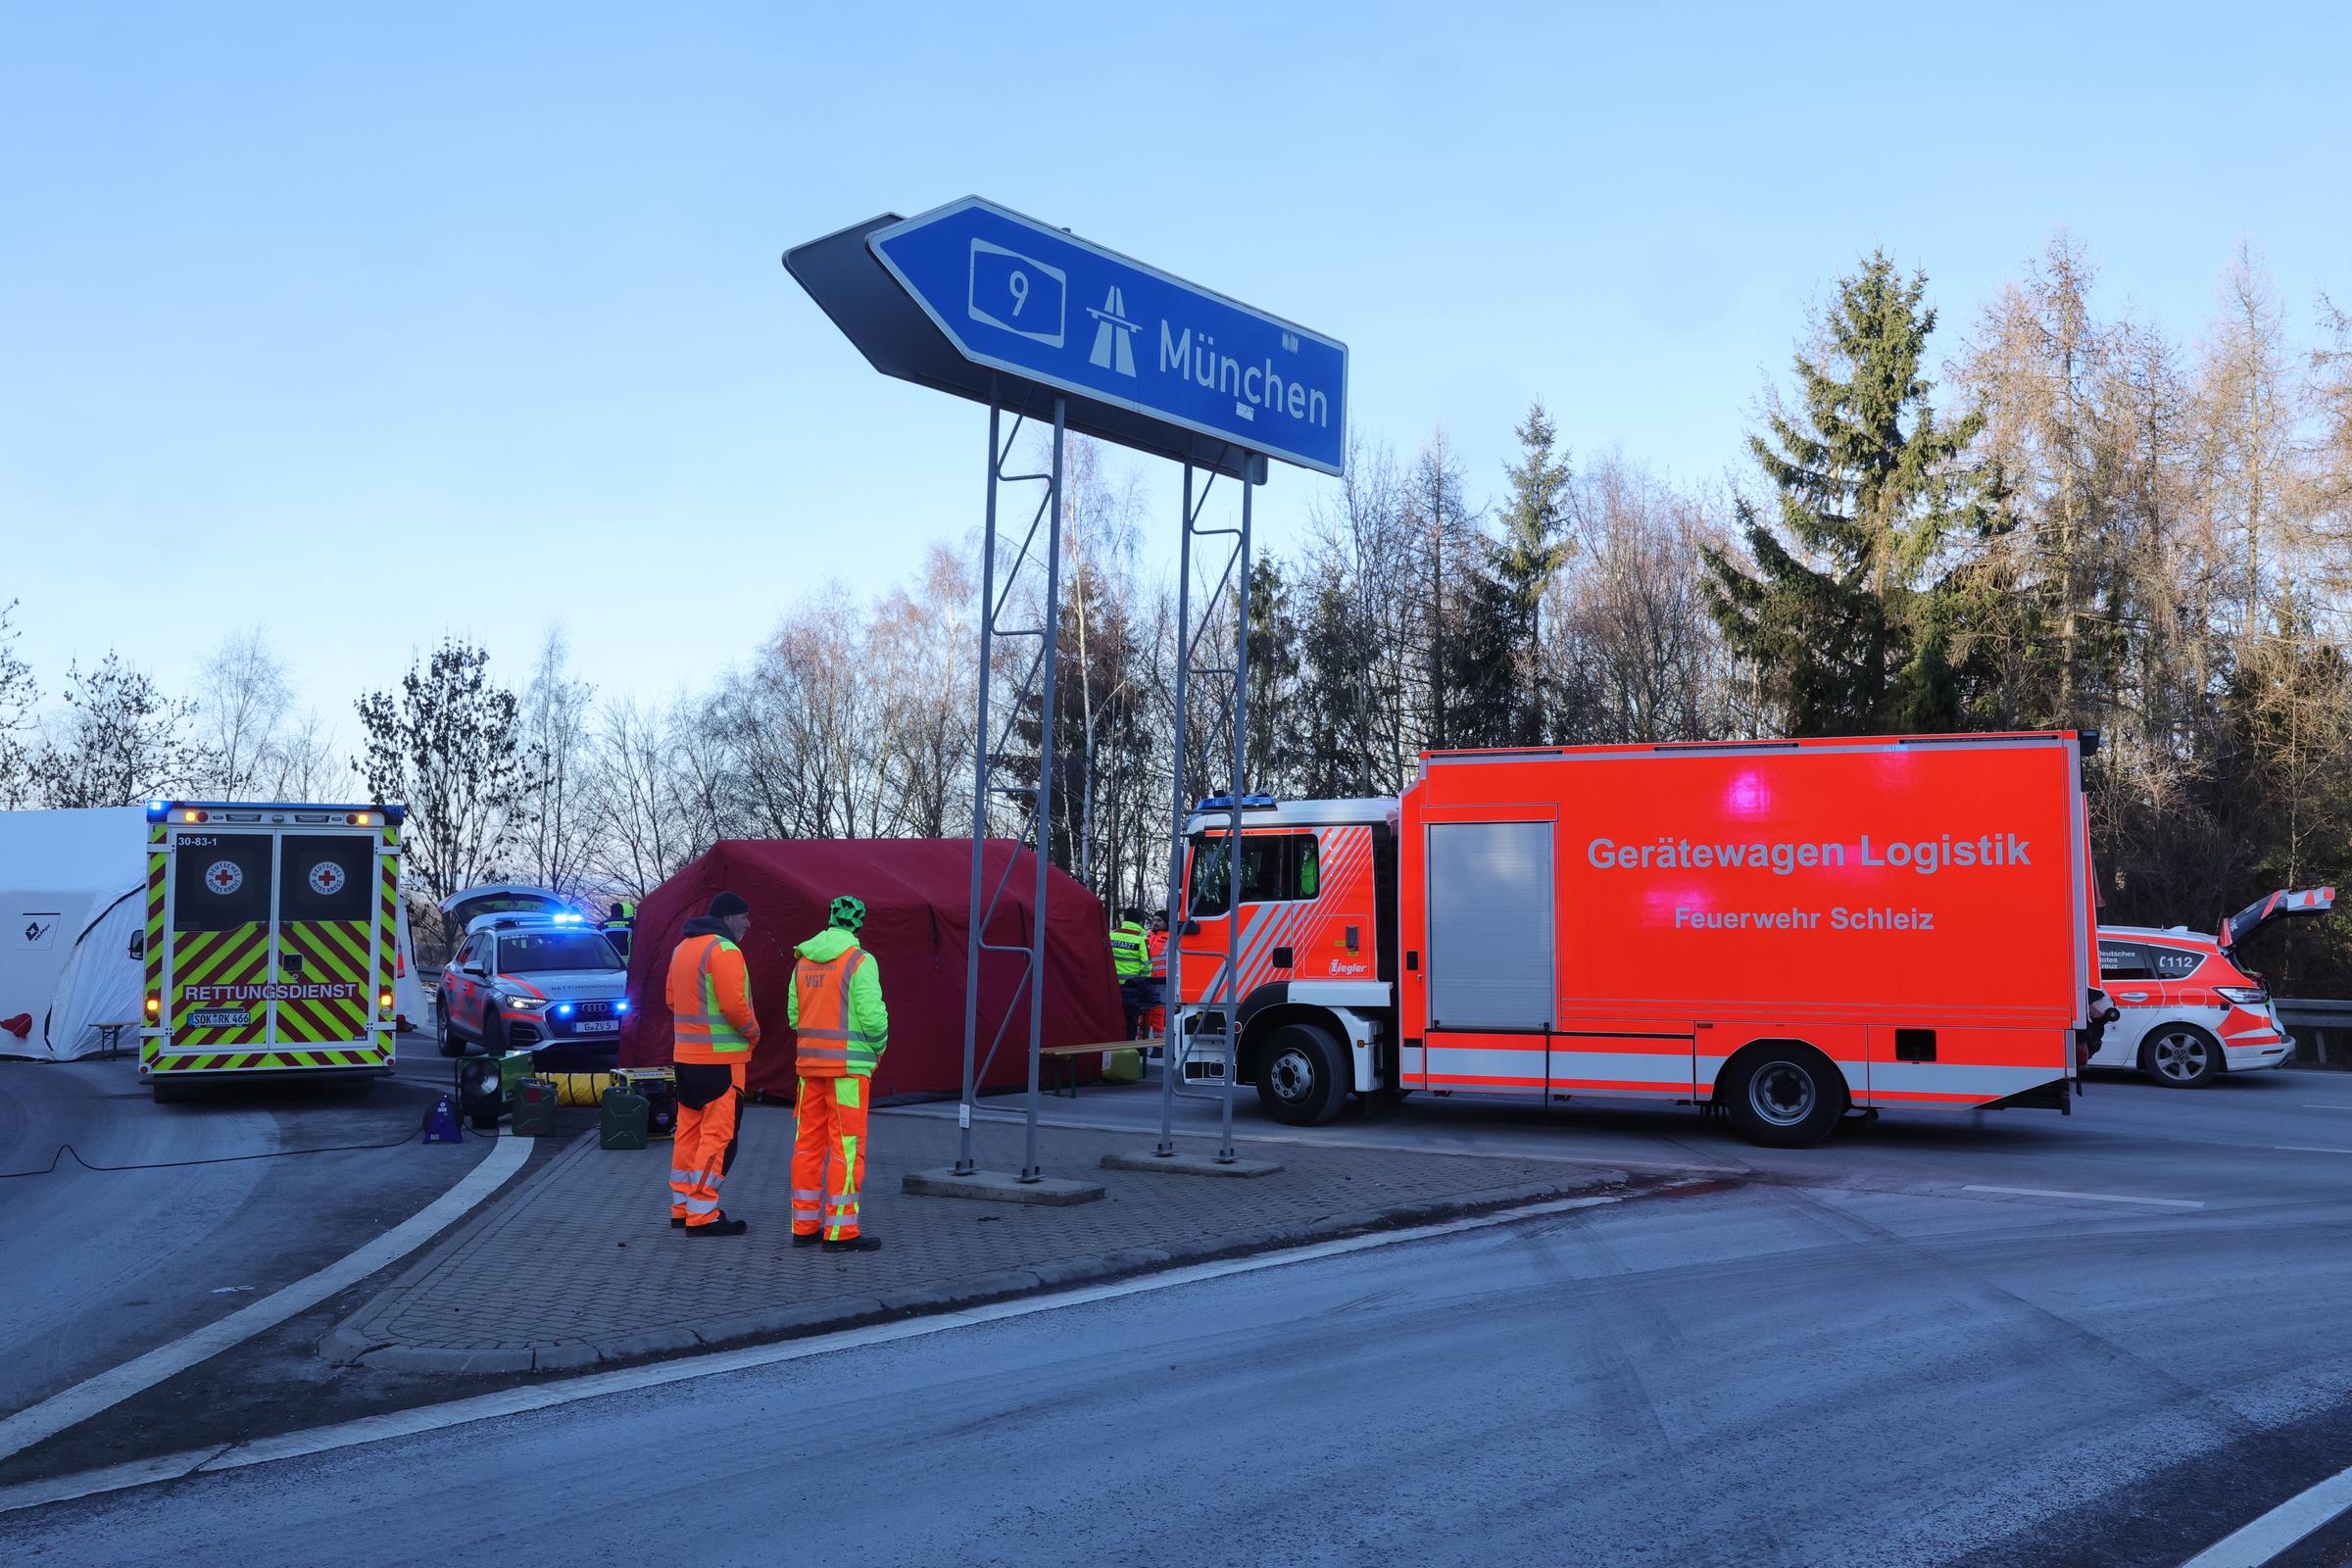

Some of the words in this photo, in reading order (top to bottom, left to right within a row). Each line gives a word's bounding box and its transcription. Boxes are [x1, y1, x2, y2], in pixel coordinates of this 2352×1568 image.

[1009, 270, 1029, 317] 9
[1159, 319, 1328, 428] München
[178, 837, 218, 847] 30-83-1
[1587, 837, 1844, 875] Gerätewagen
[1860, 833, 2032, 875] Logistik
[208, 861, 241, 878] DEUTSCHES
[312, 862, 343, 878] DEUTSCHES
[1675, 907, 1821, 929] Feuerwehr
[1831, 906, 1935, 930] Schleiz
[1330, 959, 1368, 975] Ziegler
[2168, 957, 2193, 968] 112
[806, 974, 825, 988] VGT
[185, 983, 357, 1001] RETTUNGSDIENST
[194, 1014, 212, 1024] SOK
[218, 1013, 230, 1024] RK
[232, 1013, 249, 1023] 466
